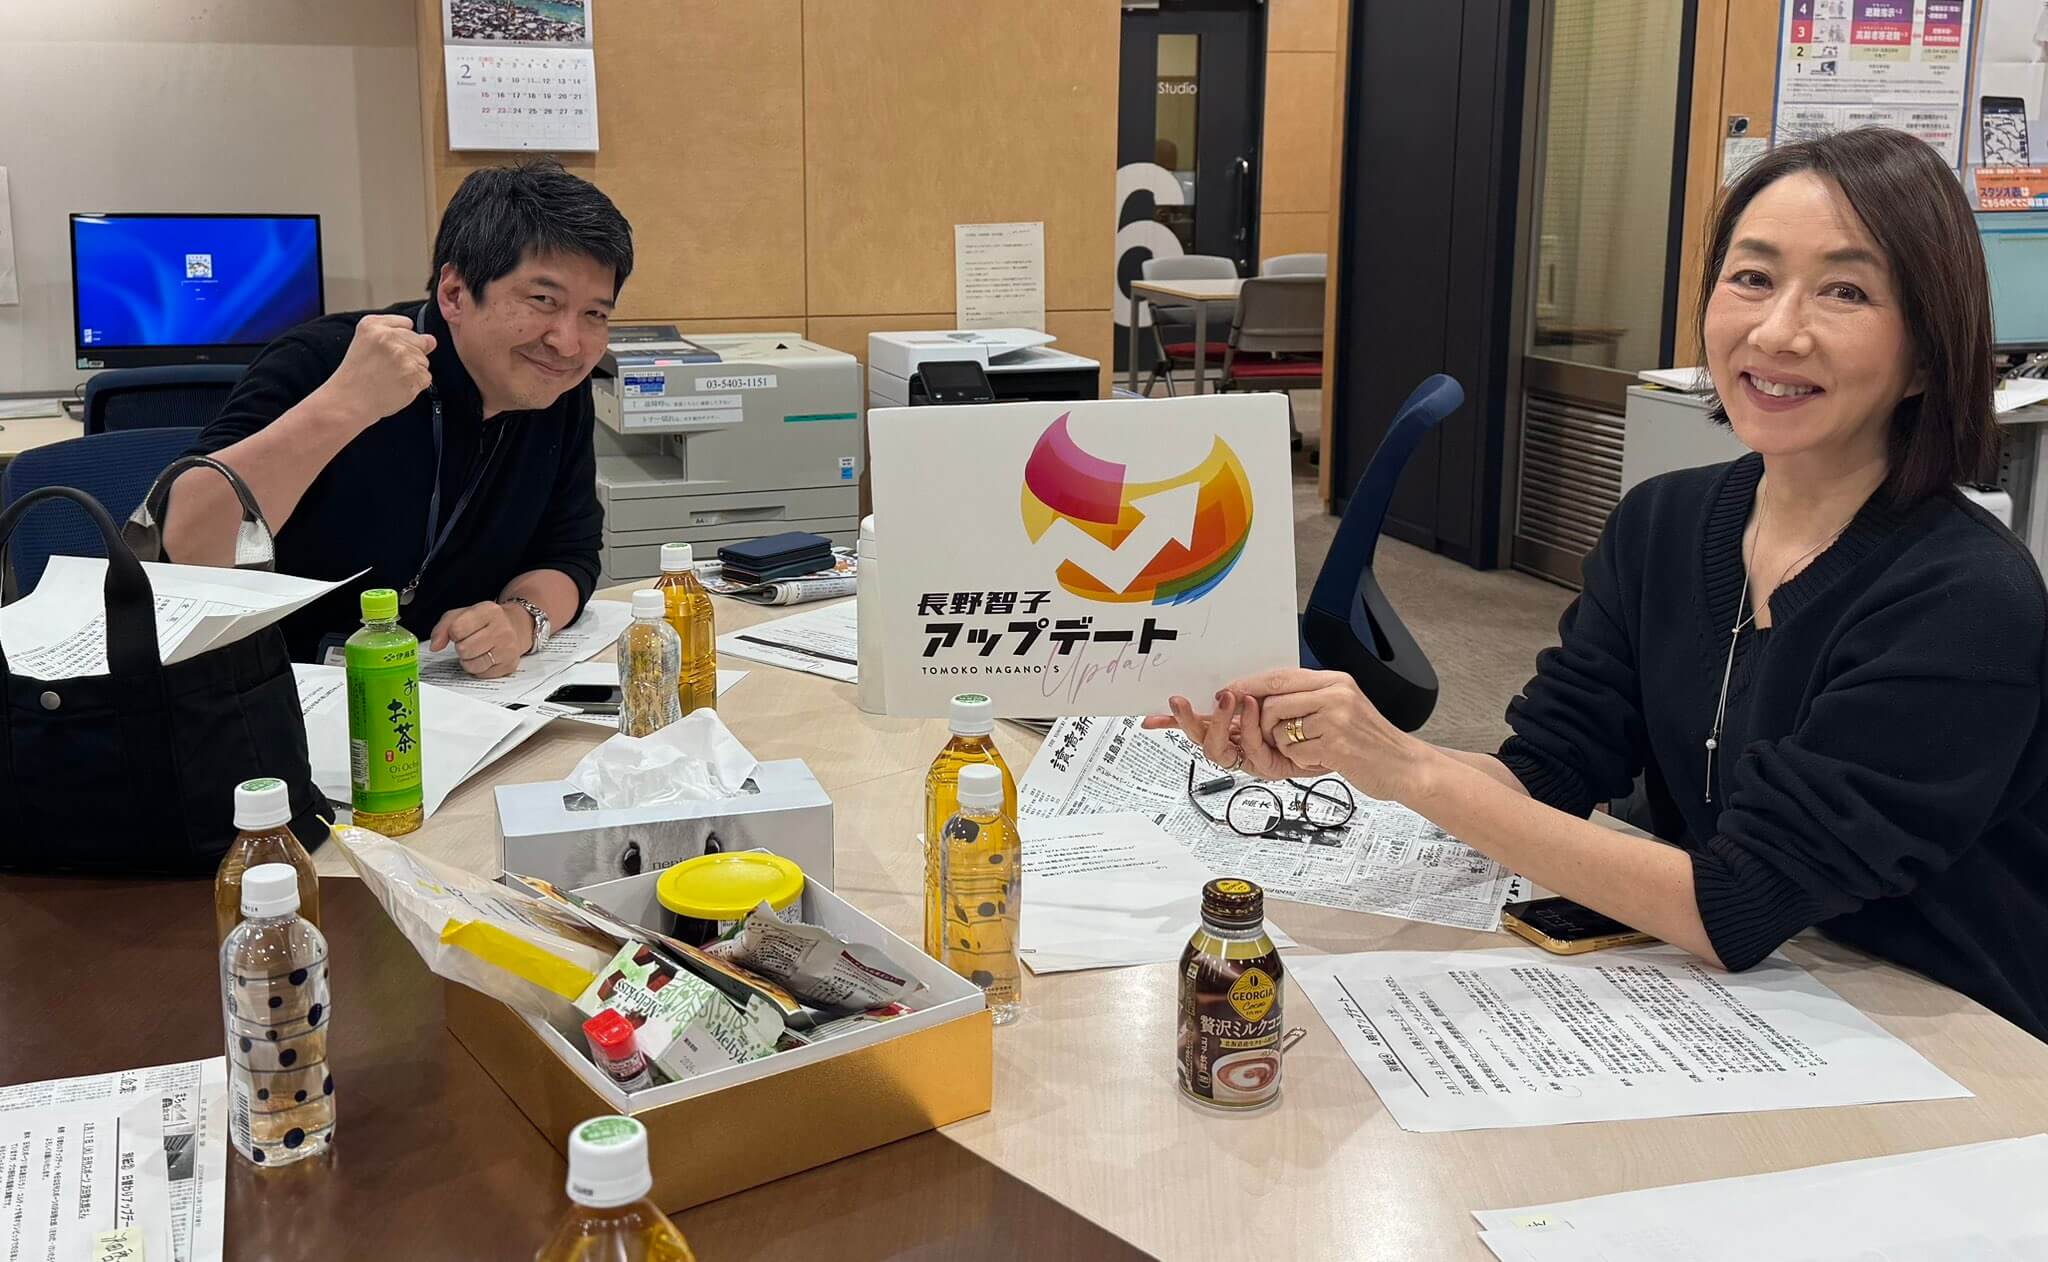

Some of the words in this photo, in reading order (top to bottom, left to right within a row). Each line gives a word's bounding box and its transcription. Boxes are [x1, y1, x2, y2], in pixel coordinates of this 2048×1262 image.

[1800, 3, 1807, 15] 4
[1798, 27, 1805, 37] 3
[1796, 47, 1804, 57] 2
[461, 64, 471, 79] 2
[1797, 64, 1801, 73] 1
[1158, 82, 1197, 94] Studio
[706, 376, 768, 390] 03-5403-1151
[917, 591, 1051, 616] 長野智子
[922, 617, 1178, 657] アップデート
[922, 667, 979, 676] TOMOKO
[985, 665, 1060, 675] NAGANO'S
[387, 698, 417, 754] お茶
[1103, 716, 1136, 765] 福島第一原
[389, 765, 401, 774] Oi
[616, 980, 661, 1018] Meltykiss
[1232, 988, 1274, 1001] GEORGIA
